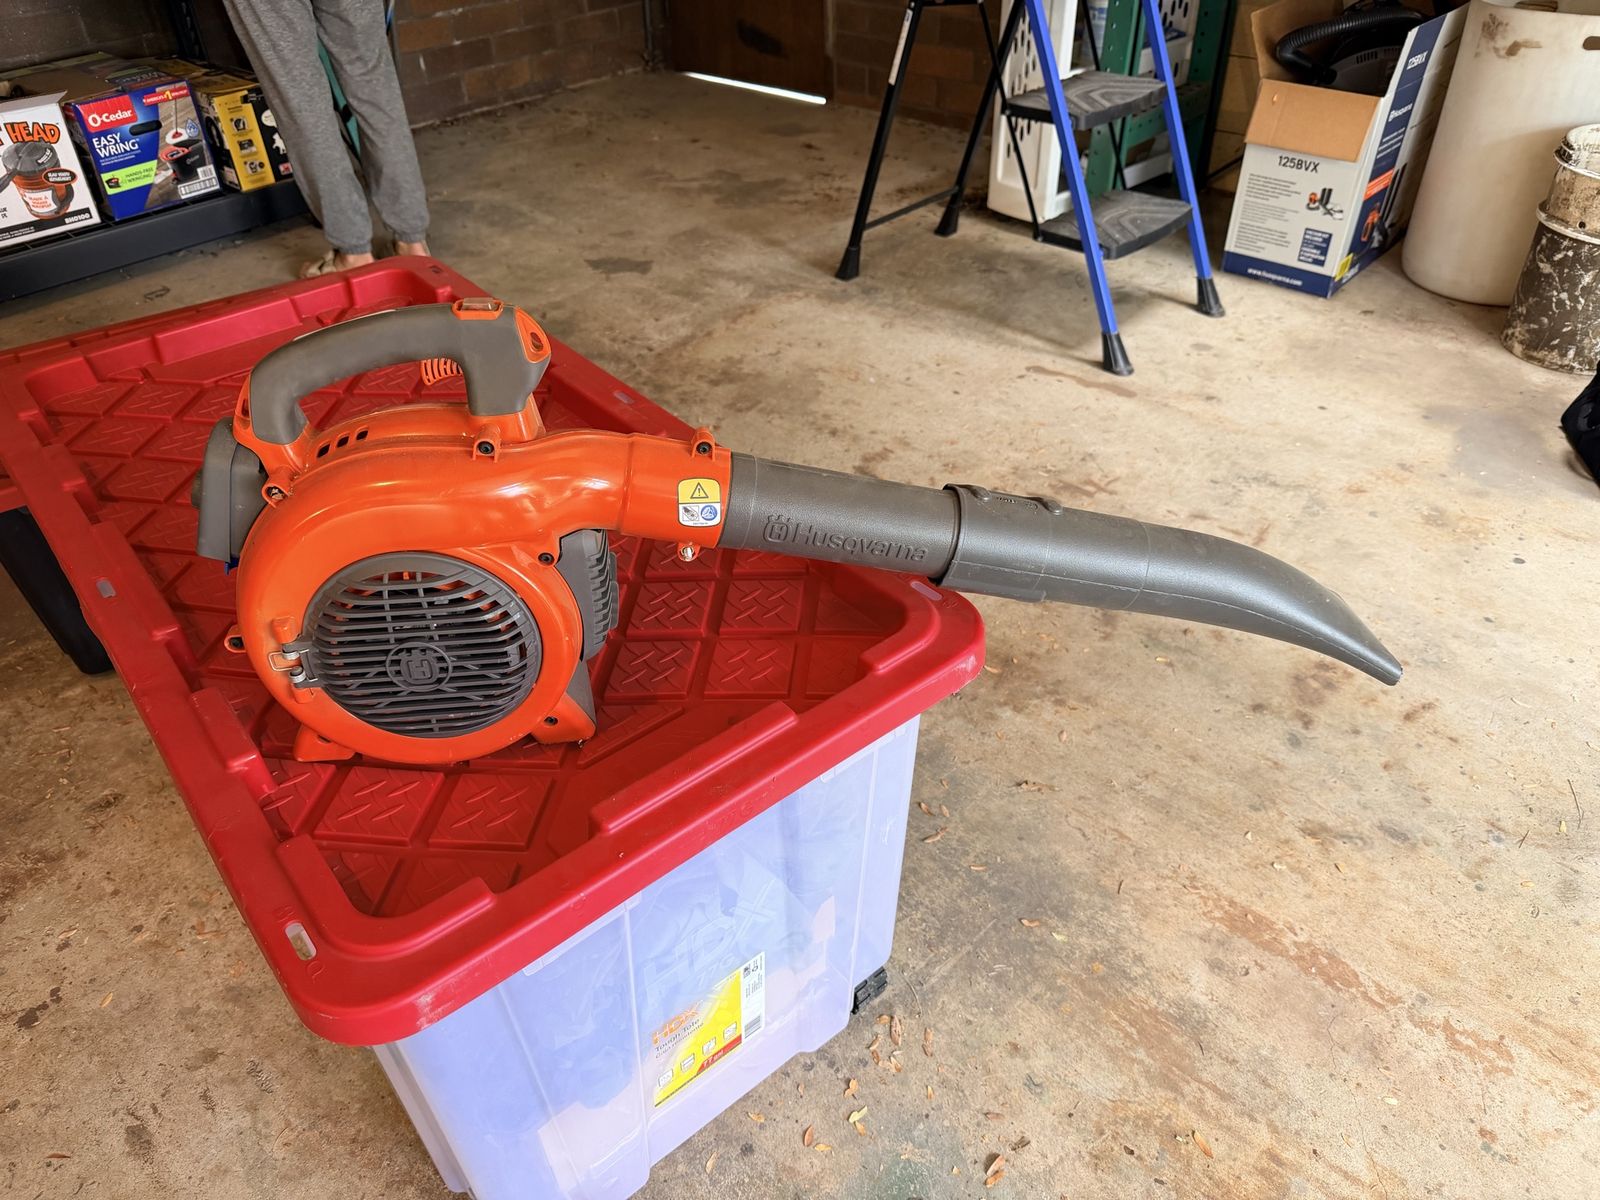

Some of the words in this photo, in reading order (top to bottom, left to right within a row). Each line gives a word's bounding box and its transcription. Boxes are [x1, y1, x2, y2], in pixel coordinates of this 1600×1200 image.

[4, 121, 60, 144] HEAD
[92, 132, 121, 149] EASY
[96, 139, 139, 158] WRING
[1278, 155, 1320, 174] 125BVX
[791, 522, 928, 562] Husqvarna
